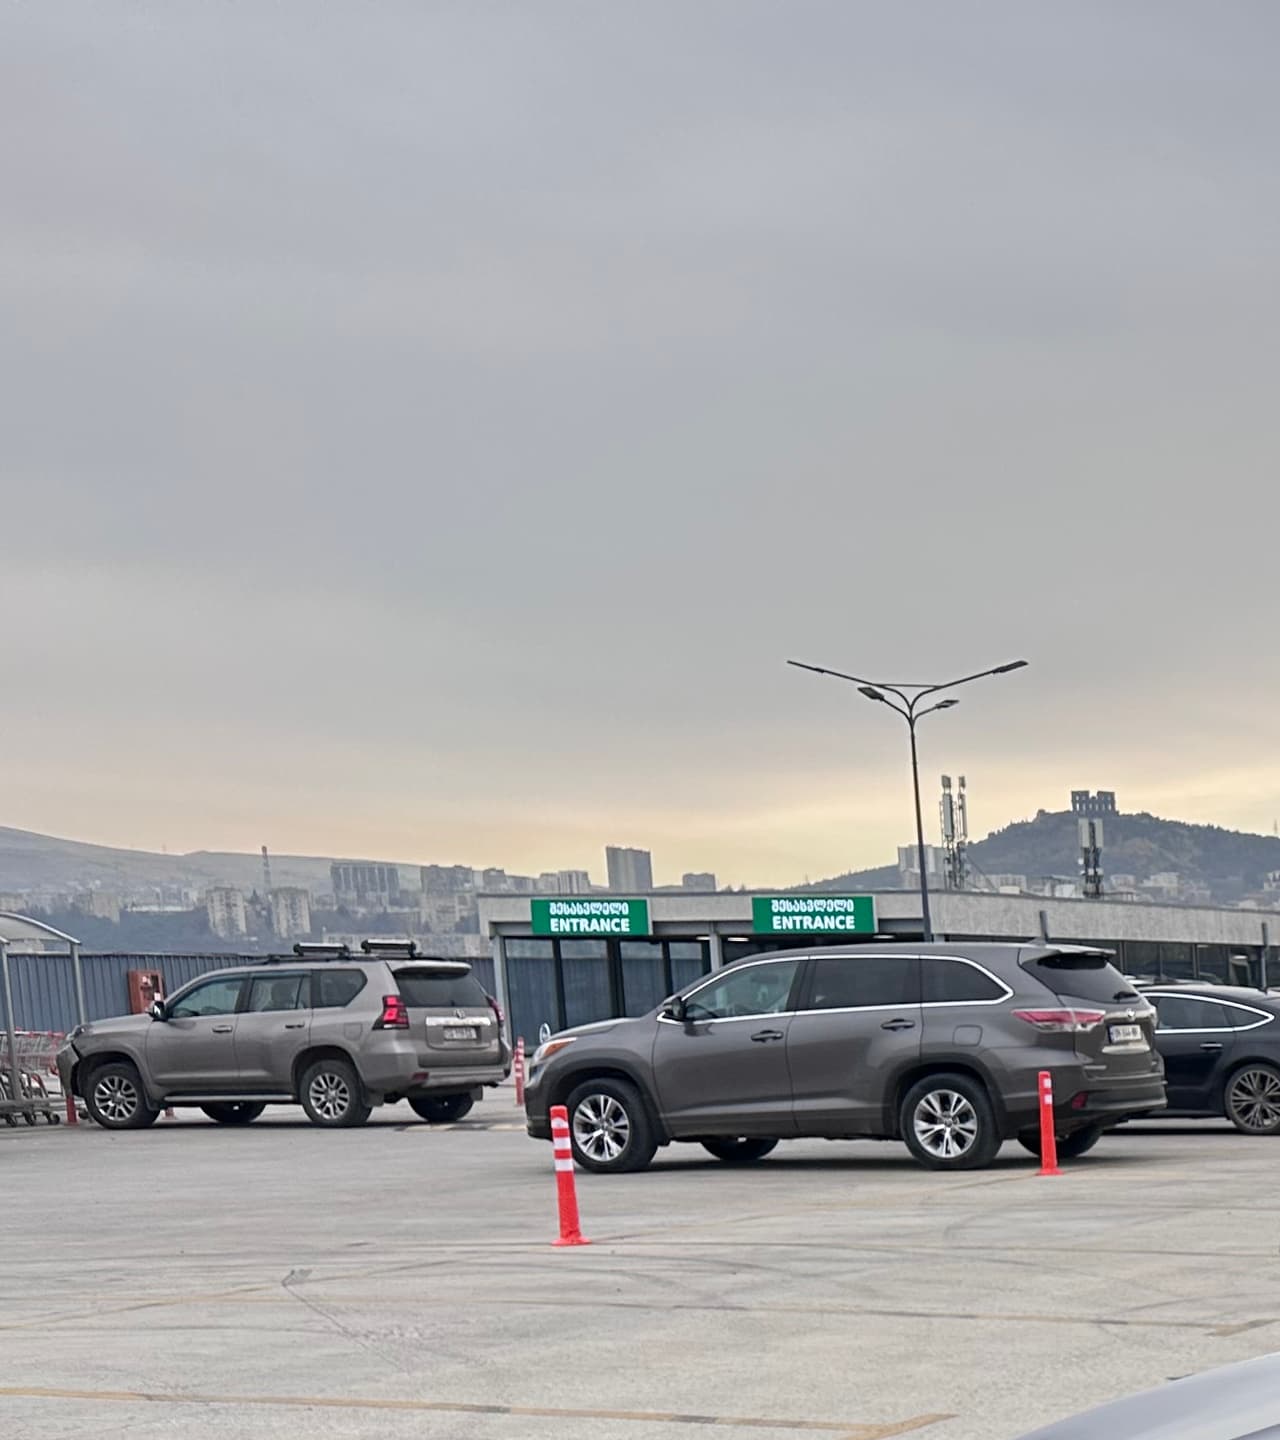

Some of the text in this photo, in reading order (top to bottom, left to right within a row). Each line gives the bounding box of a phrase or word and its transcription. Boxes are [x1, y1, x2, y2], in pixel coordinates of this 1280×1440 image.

[549, 901, 629, 915] შესასვლელი
[771, 899, 854, 912] შესასვლელი
[550, 918, 630, 932] ENTRANCE
[772, 915, 855, 929] ENTRANCE
